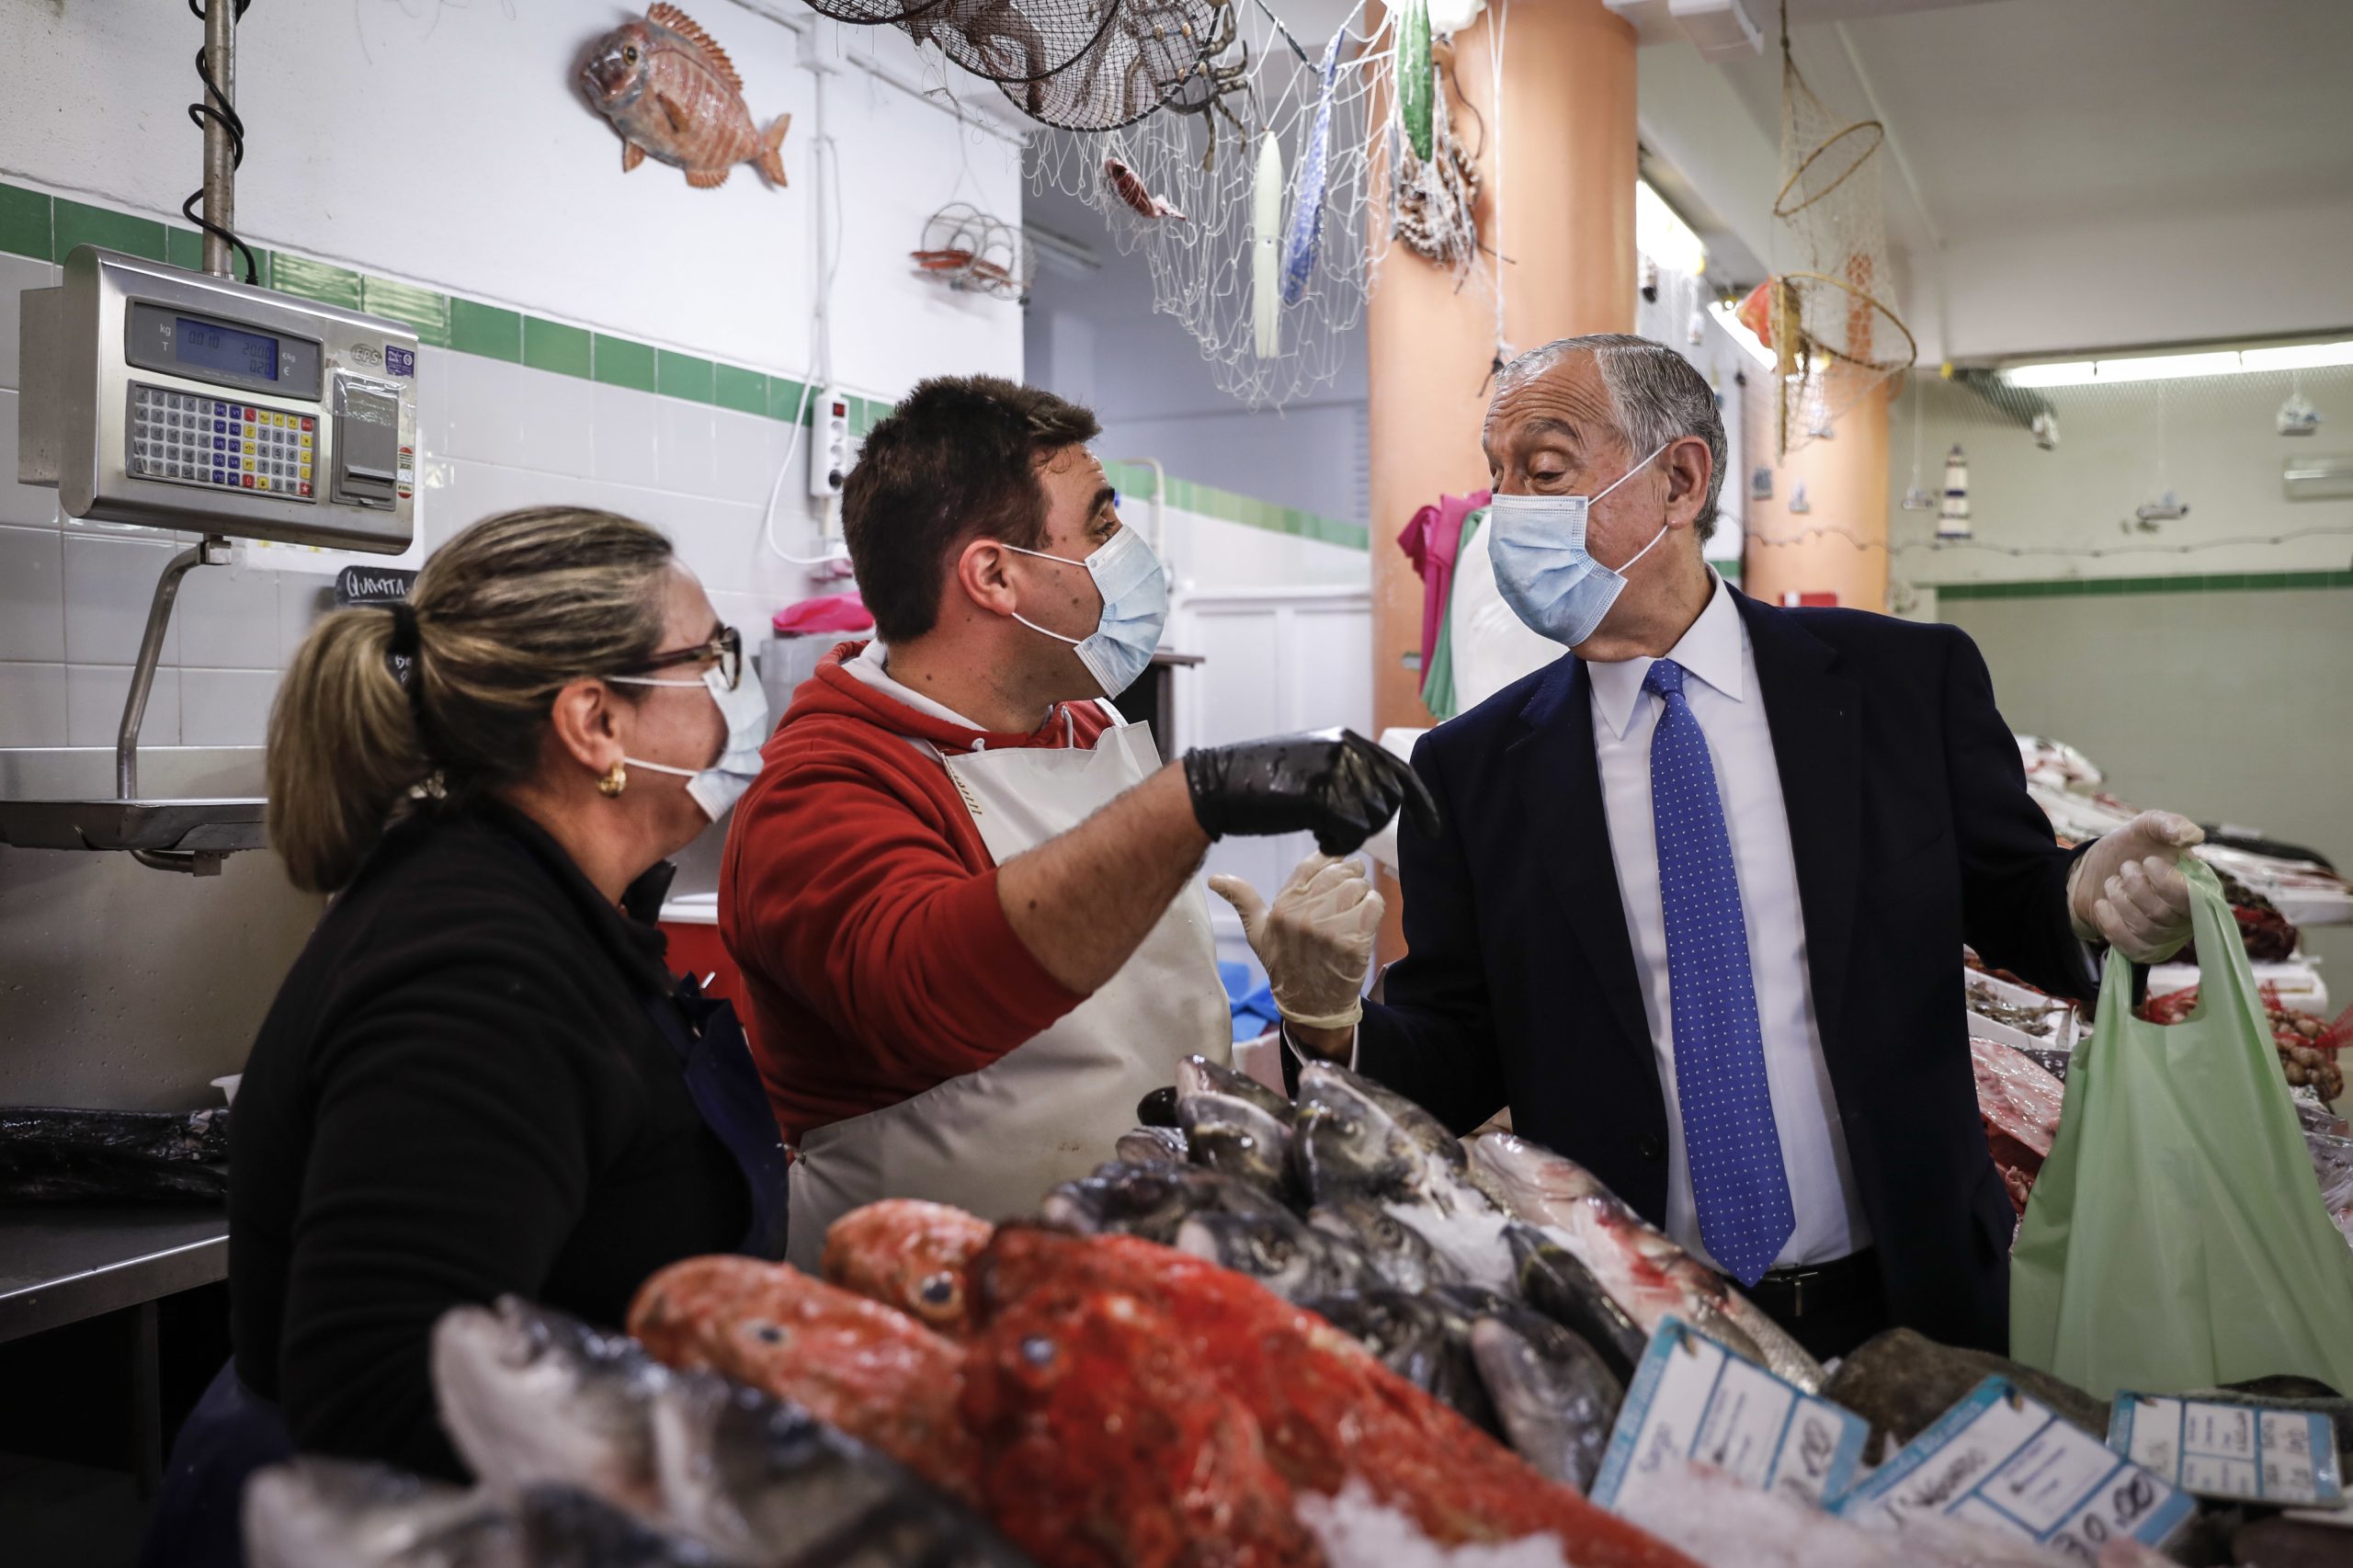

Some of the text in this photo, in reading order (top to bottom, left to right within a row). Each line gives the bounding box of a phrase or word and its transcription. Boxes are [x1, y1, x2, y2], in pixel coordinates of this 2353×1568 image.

[160, 324, 171, 336] kg
[162, 341, 169, 351] T
[355, 348, 379, 365] EPS
